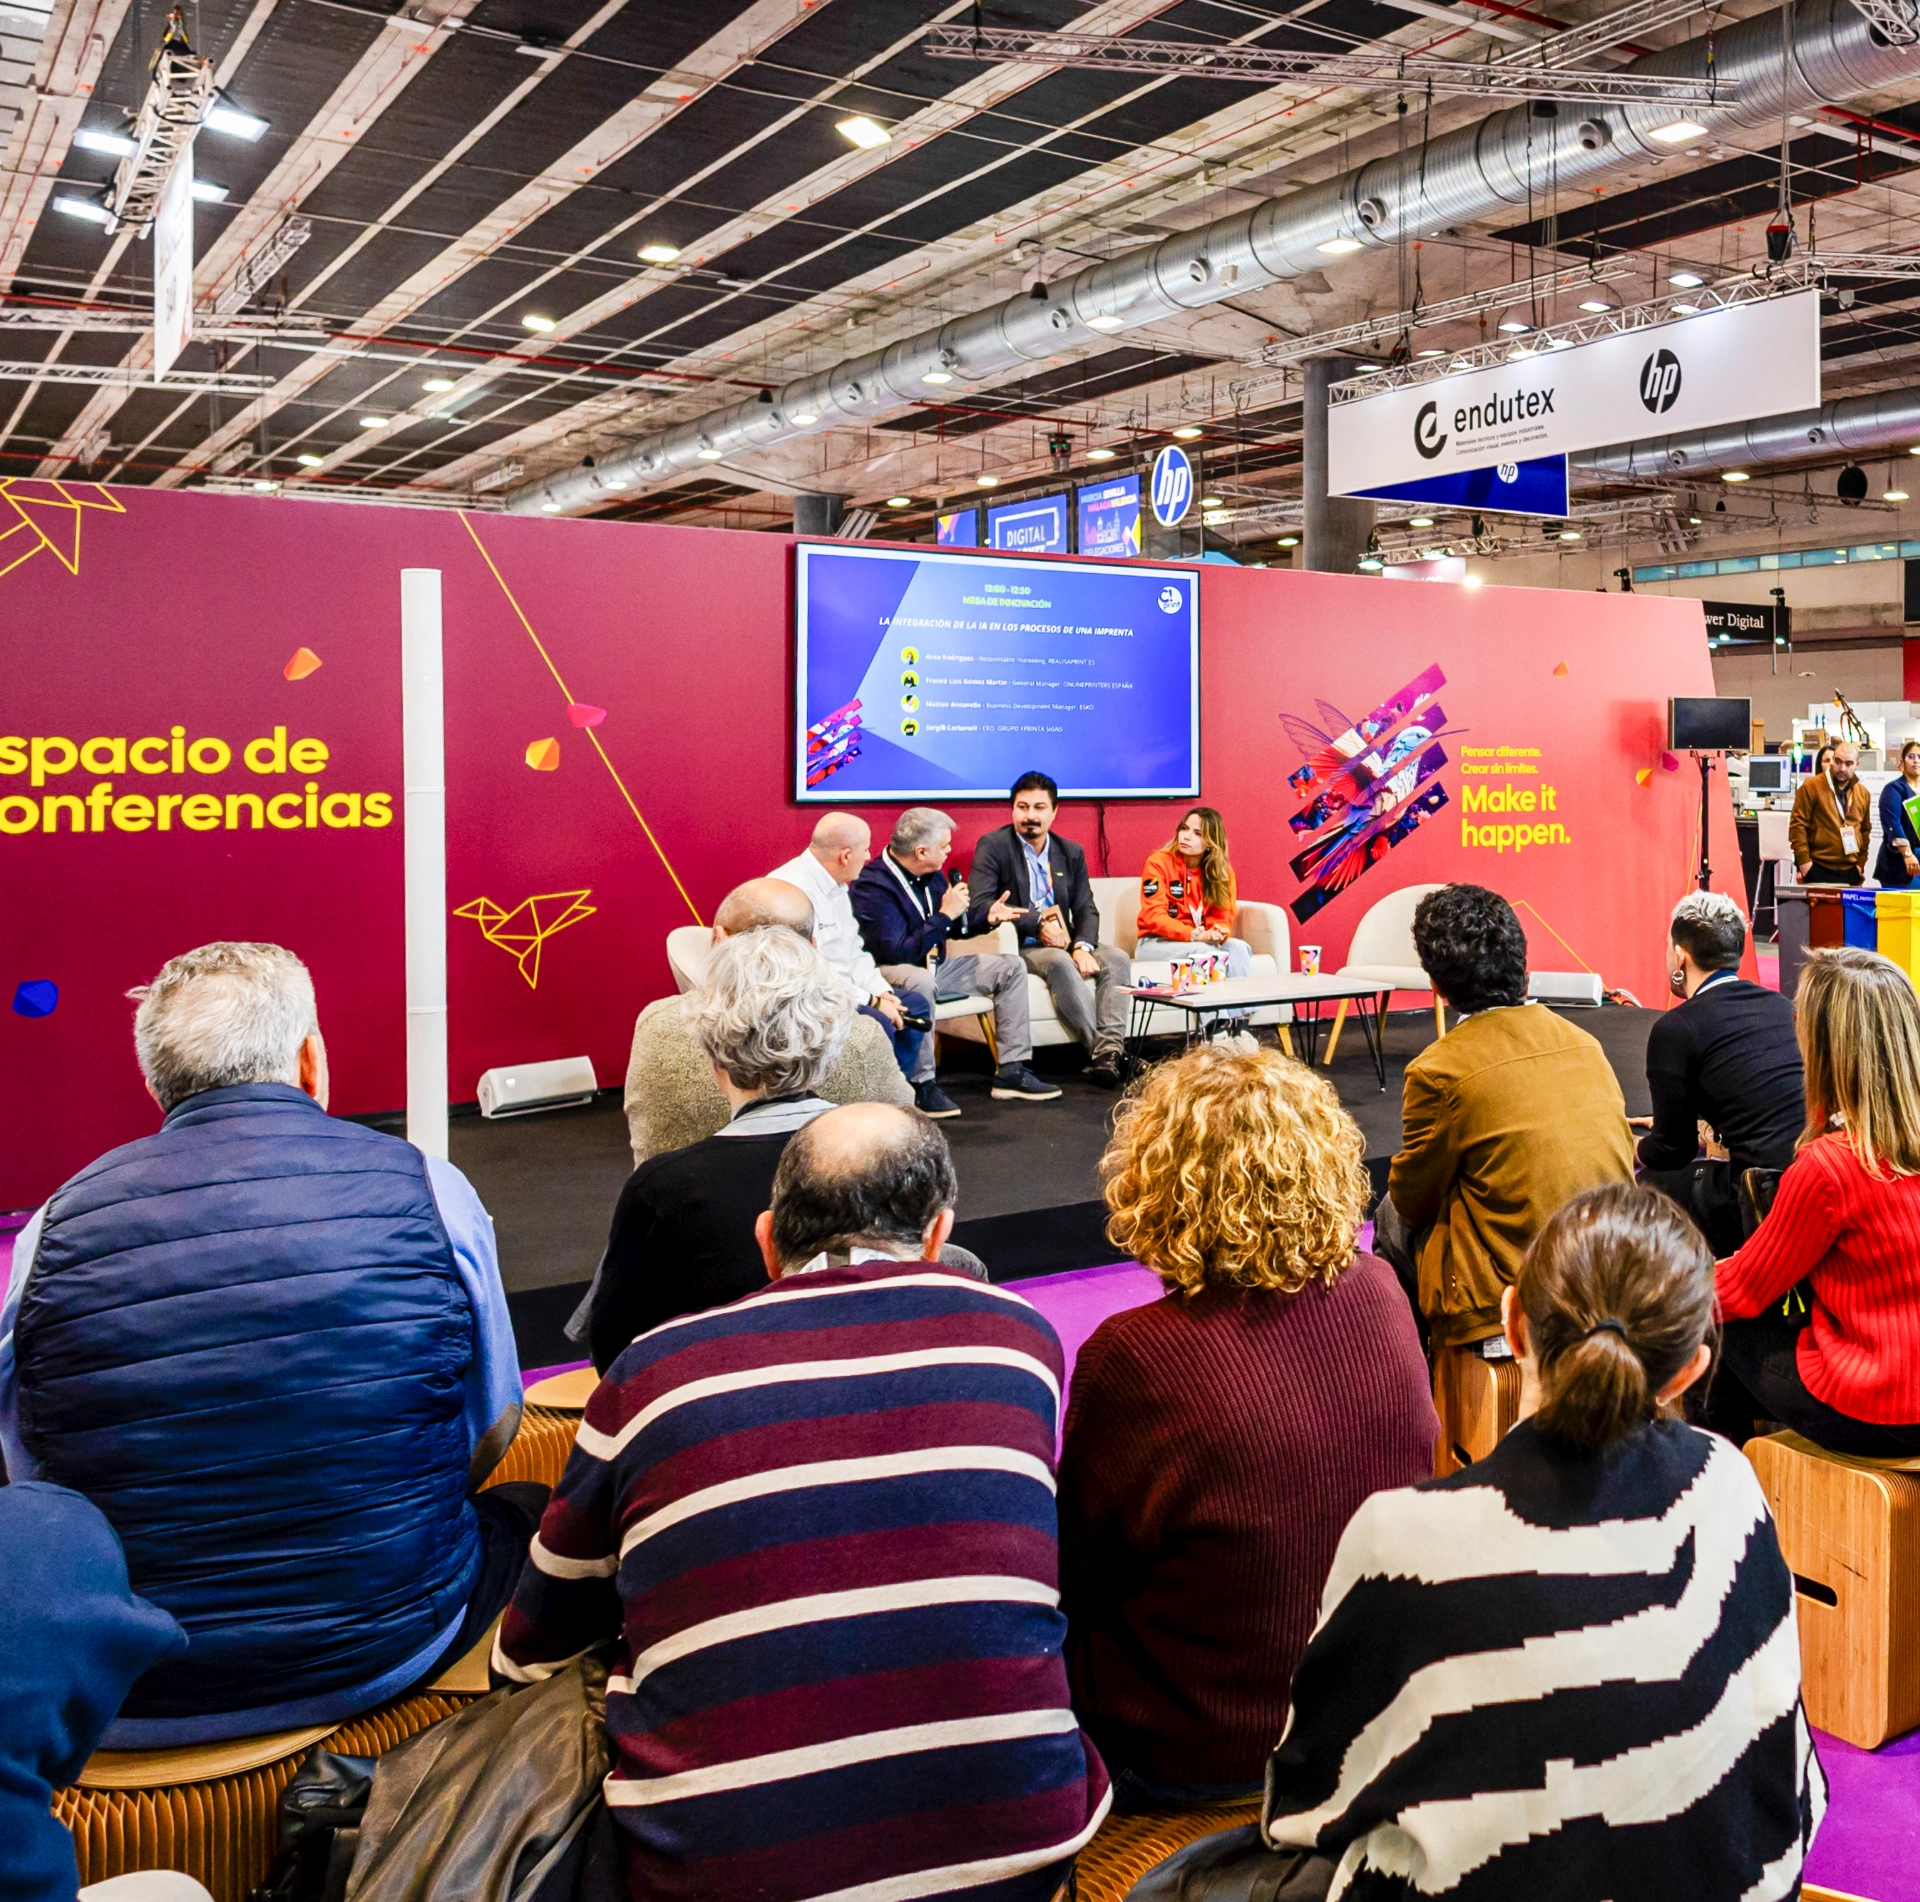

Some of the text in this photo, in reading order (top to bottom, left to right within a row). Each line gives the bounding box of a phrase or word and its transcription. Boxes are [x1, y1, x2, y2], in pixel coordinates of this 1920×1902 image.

[1642, 349, 1680, 414] hp
[1454, 388, 1555, 433] endutex
[1500, 463, 1516, 483] hp
[1102, 486, 1126, 498] SEVILLA
[1155, 446, 1190, 526] hp
[1006, 526, 1046, 547] DIGITAL
[984, 584, 1006, 593] 12:00
[962, 596, 1052, 608] MESA DE INNOVACIÓN
[879, 617, 1134, 637] LA INTEGRACIÓN DE LA IA EN LOS PROCESOS DE UNA IMPRENTA
[1727, 613, 1764, 630] Digital
[1112, 681, 1133, 689] ESPAÑA
[1013, 703, 1051, 711] Development
[0, 725, 330, 787] spacio de
[1460, 746, 1542, 757] Pensar diferente.
[1460, 762, 1490, 774] Crear
[1490, 762, 1504, 774] sin
[1461, 783, 1557, 813] Make it
[1461, 818, 1572, 854] happen.
[1843, 893, 1859, 901] PAPEL
